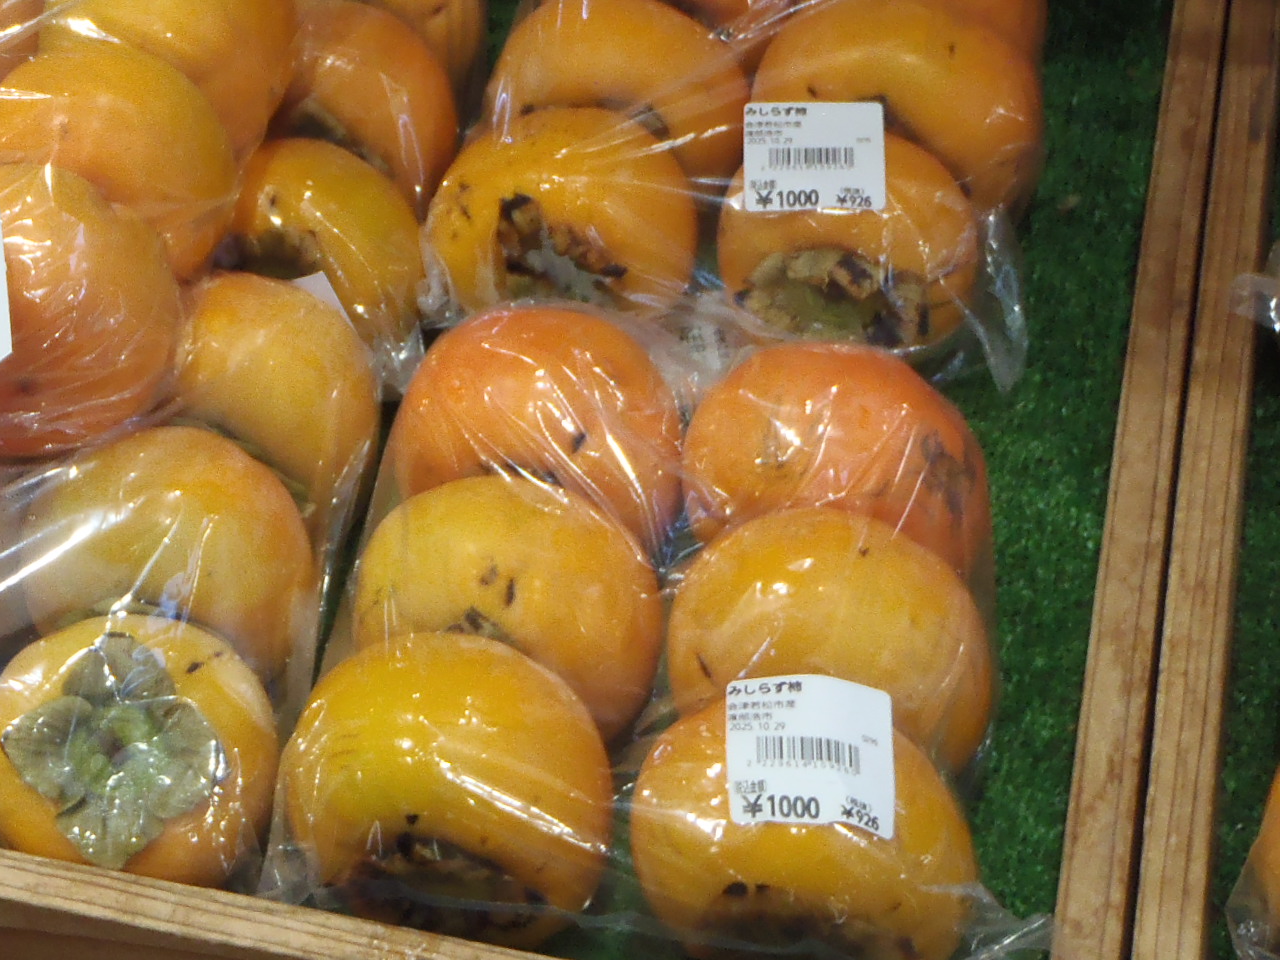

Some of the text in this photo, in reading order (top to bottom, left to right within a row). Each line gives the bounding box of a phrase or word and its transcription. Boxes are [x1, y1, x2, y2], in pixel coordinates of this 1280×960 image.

[755, 189, 872, 209] ¥1000 ¥926
[728, 681, 803, 696] みしらず柿
[741, 793, 880, 832] ¥1000 ¥926
